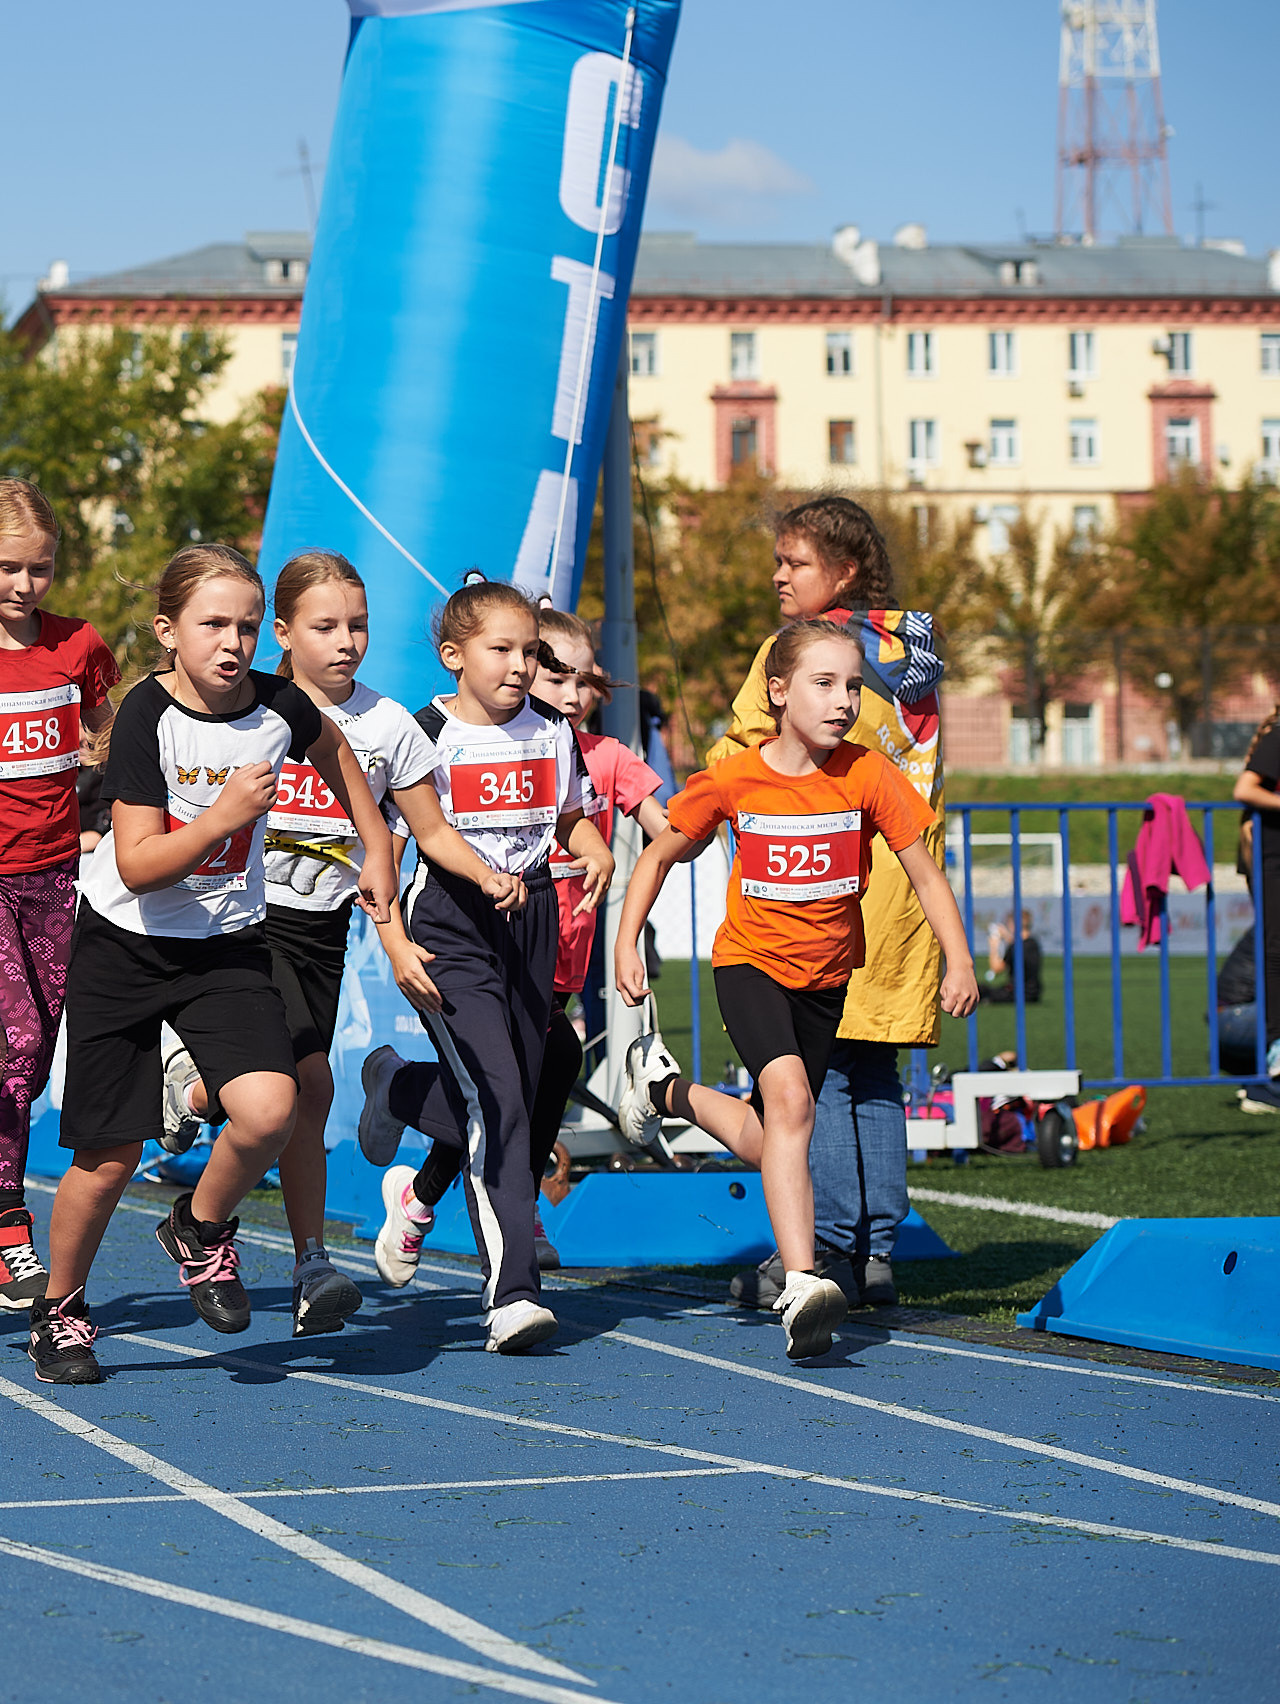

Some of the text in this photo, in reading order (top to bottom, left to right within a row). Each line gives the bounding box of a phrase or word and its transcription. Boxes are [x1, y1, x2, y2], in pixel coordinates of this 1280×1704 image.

[512, 52, 644, 612] СТА
[2, 717, 61, 755] 458
[276, 772, 336, 810] 543
[479, 769, 534, 805] 345
[759, 821, 815, 830] Динамовская
[766, 843, 832, 878] 525
